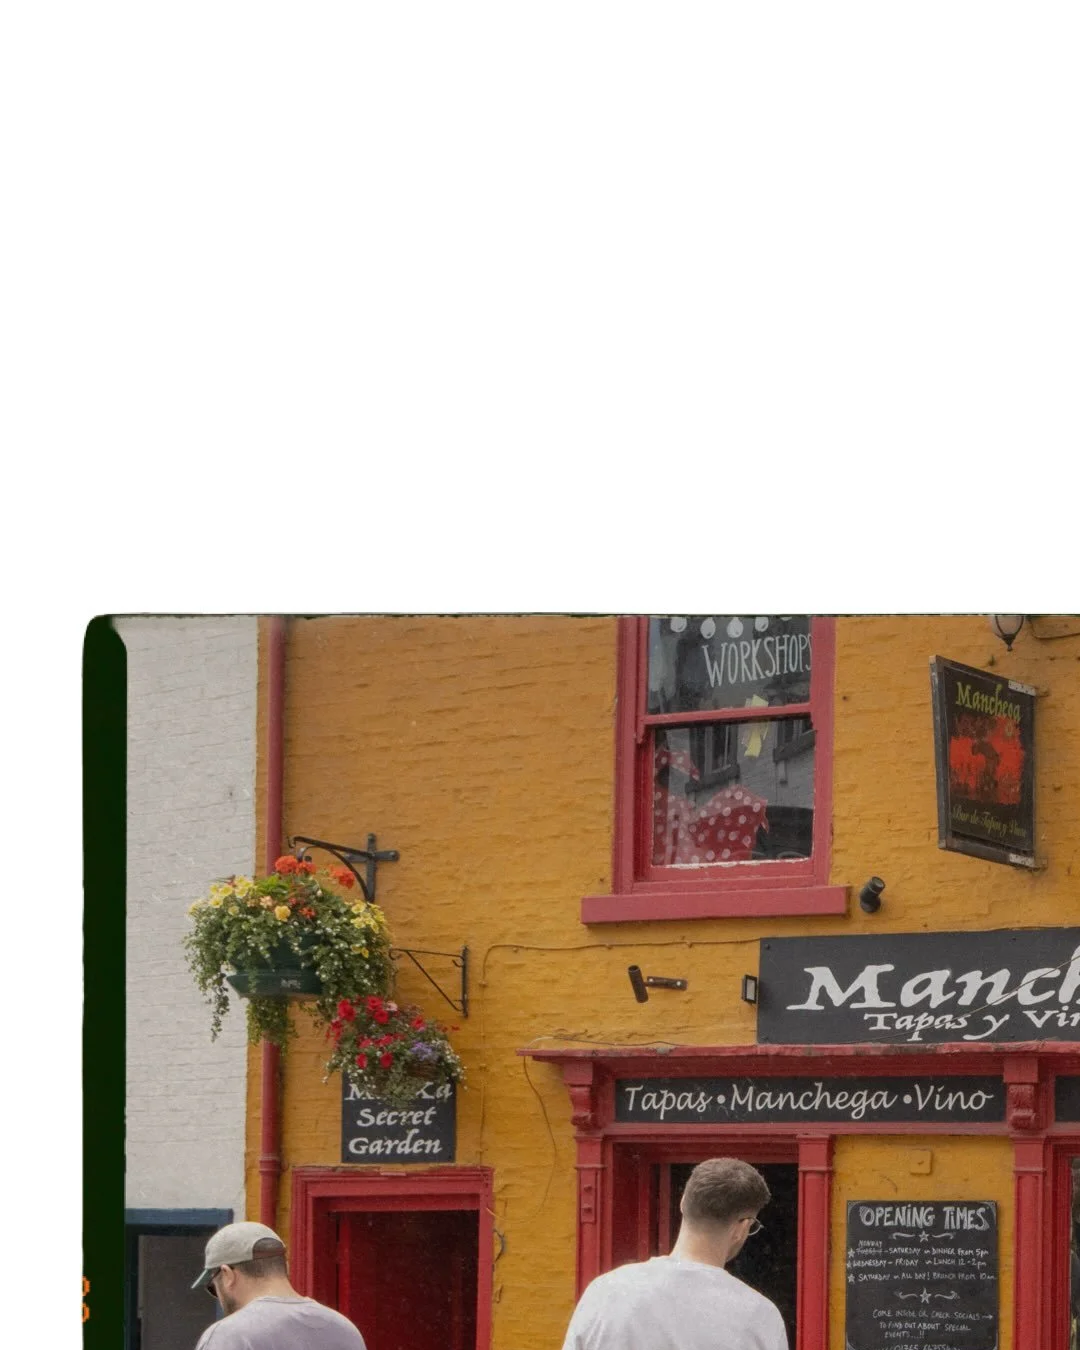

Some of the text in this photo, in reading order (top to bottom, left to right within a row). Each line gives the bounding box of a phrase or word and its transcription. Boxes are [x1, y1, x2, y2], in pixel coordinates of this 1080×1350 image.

[701, 634, 812, 688] WORKSHOPS
[955, 681, 1022, 733] Manchega
[863, 1012, 970, 1042] Tapas
[964, 1013, 1008, 1039] y
[625, 1082, 995, 1120] Tapas Manchega Vino
[356, 1107, 437, 1127] Secret
[349, 1128, 443, 1155] Garden
[859, 1204, 936, 1229] OPENING
[889, 1247, 921, 1256] SATURDAY
[931, 1248, 956, 1256] DINNER
[976, 1249, 989, 1259] 5pm
[933, 1257, 956, 1265] LUNCH
[858, 1273, 891, 1282] SATURDAY
[901, 1272, 913, 1280] ALL
[872, 1309, 893, 1319] COME
[879, 1321, 887, 1329] TO
[904, 1322, 916, 1330] OUT
[917, 1322, 941, 1330] ABOUT
